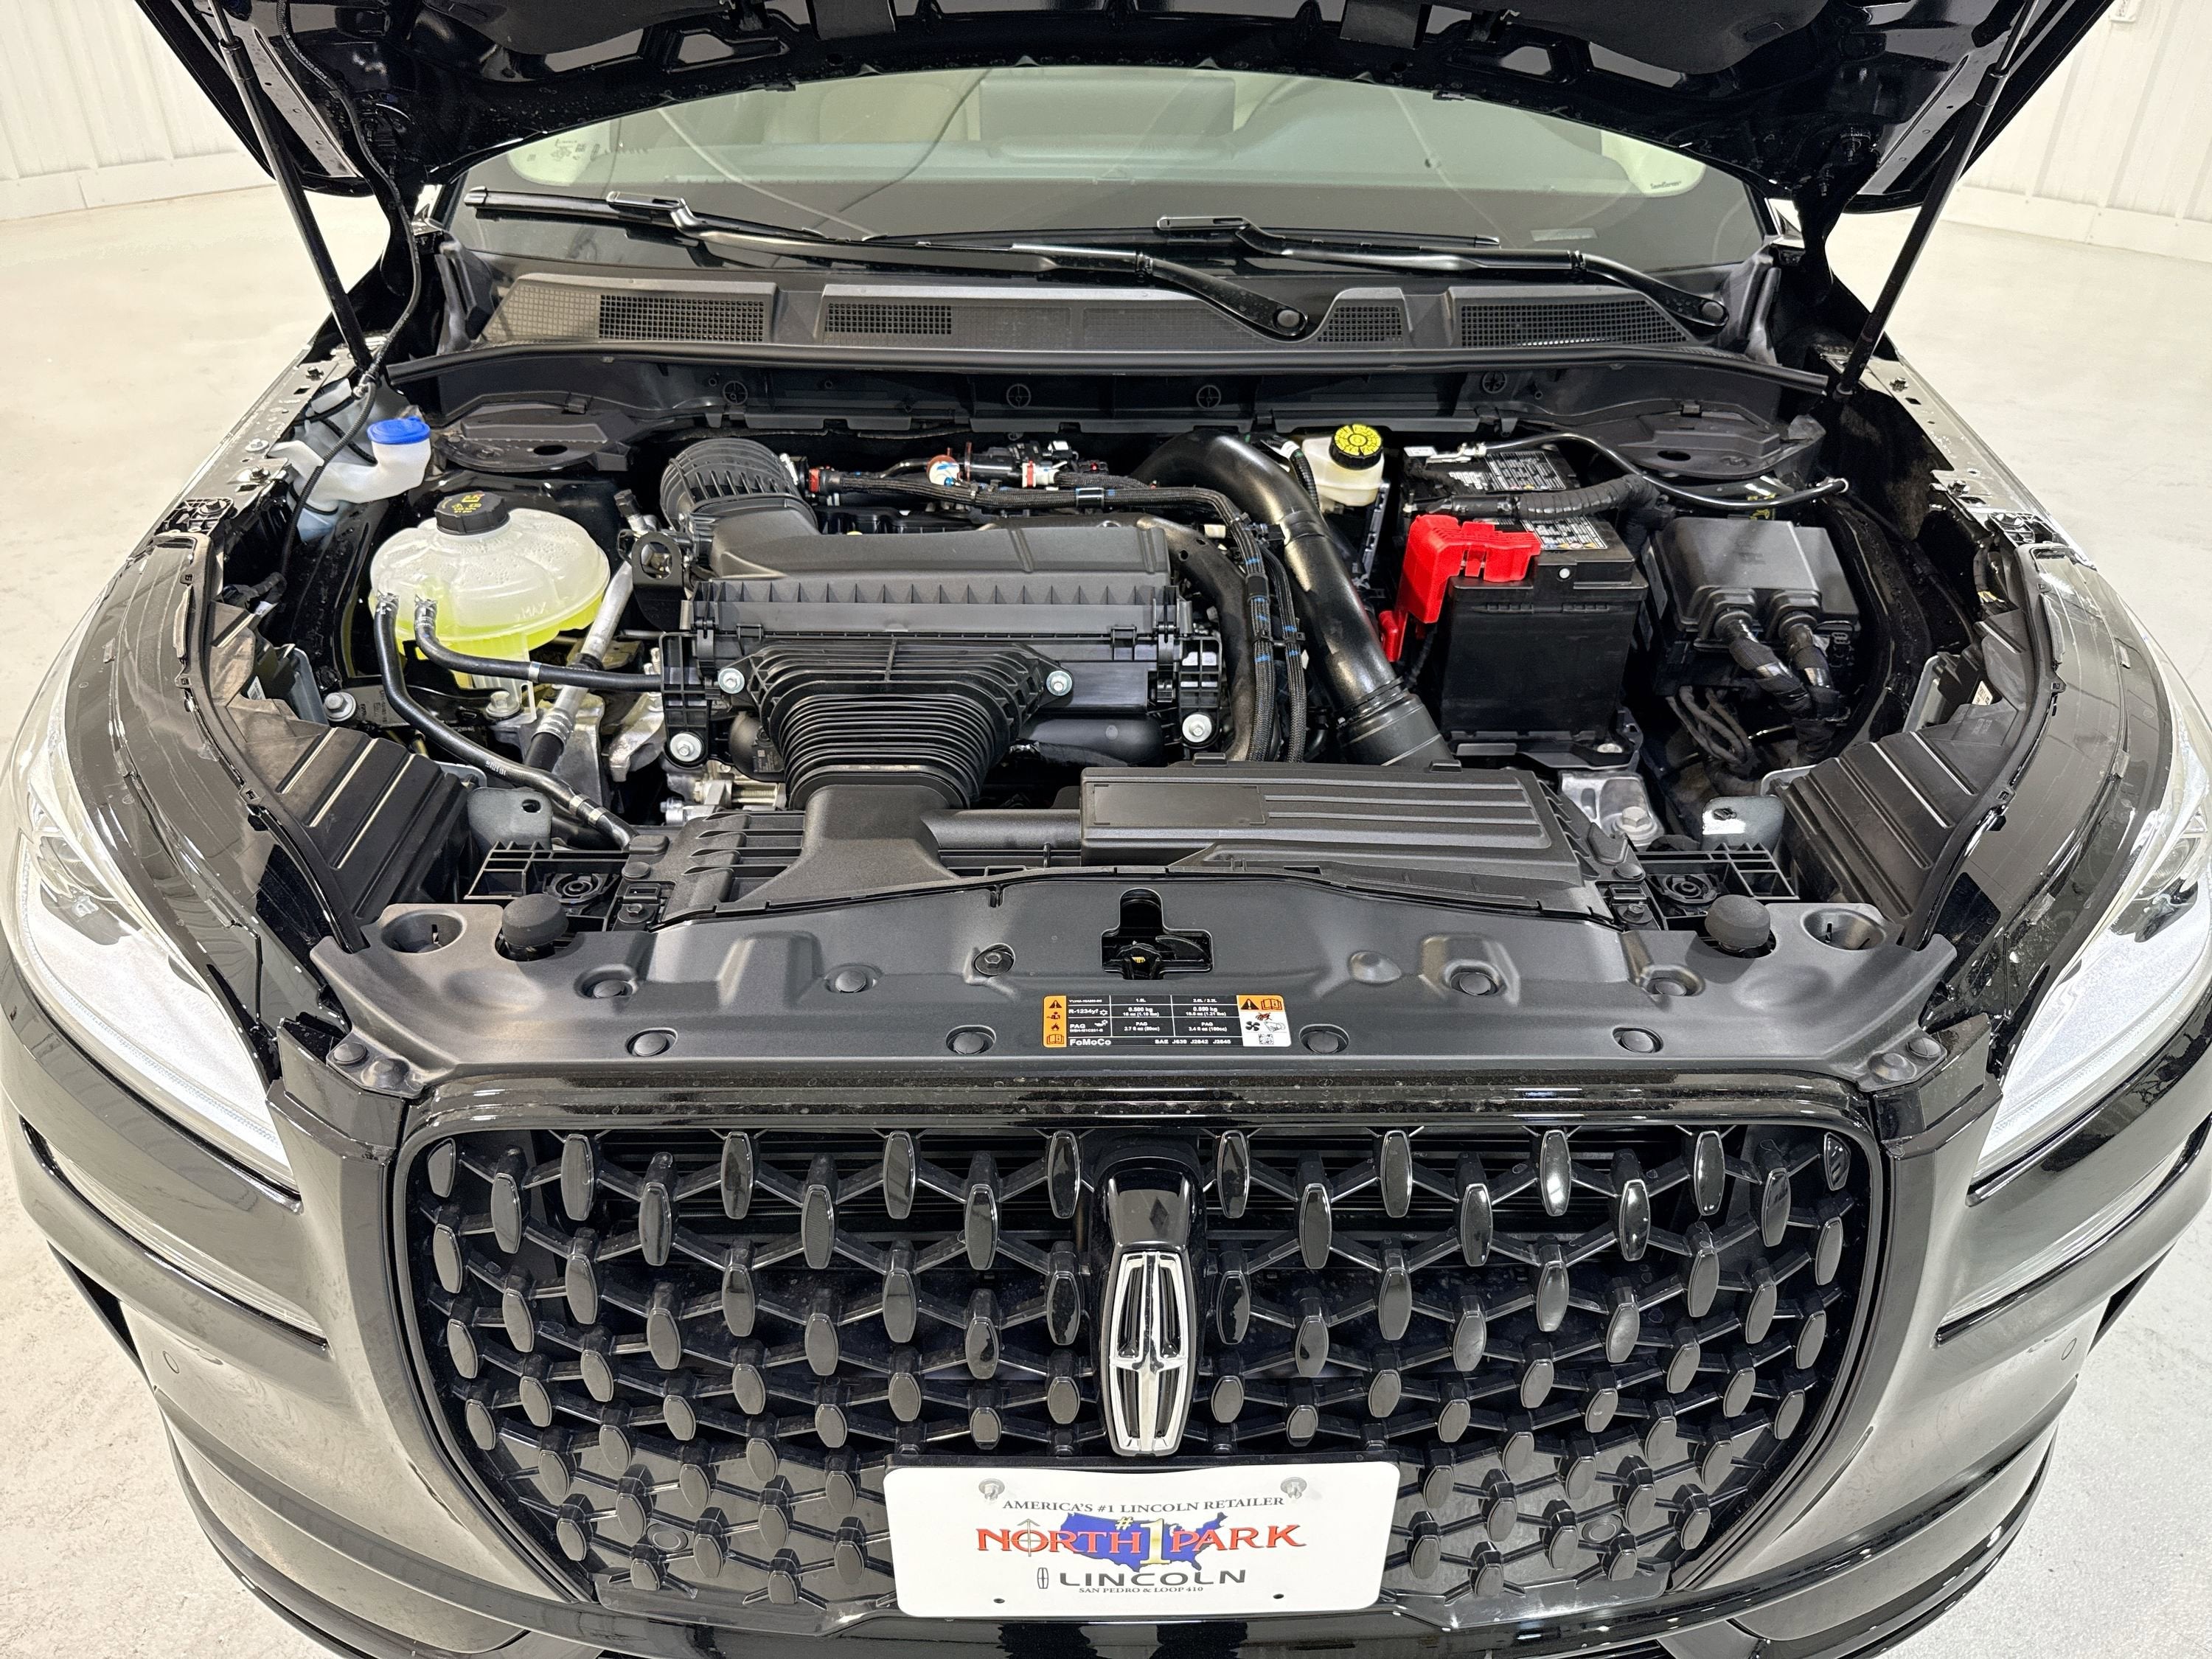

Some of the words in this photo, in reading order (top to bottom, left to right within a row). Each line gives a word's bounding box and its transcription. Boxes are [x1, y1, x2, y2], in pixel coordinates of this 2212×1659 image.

[1003, 1500, 1093, 1512] AMERICA'S
[1098, 1504, 1114, 1513] #1
[1120, 1502, 1200, 1513] LINCOLN
[1203, 1497, 1284, 1510] RETAILER
[975, 1528, 1142, 1554] NORTH
[1170, 1524, 1307, 1554] PARK
[1059, 1569, 1246, 1587] LINCOLN
